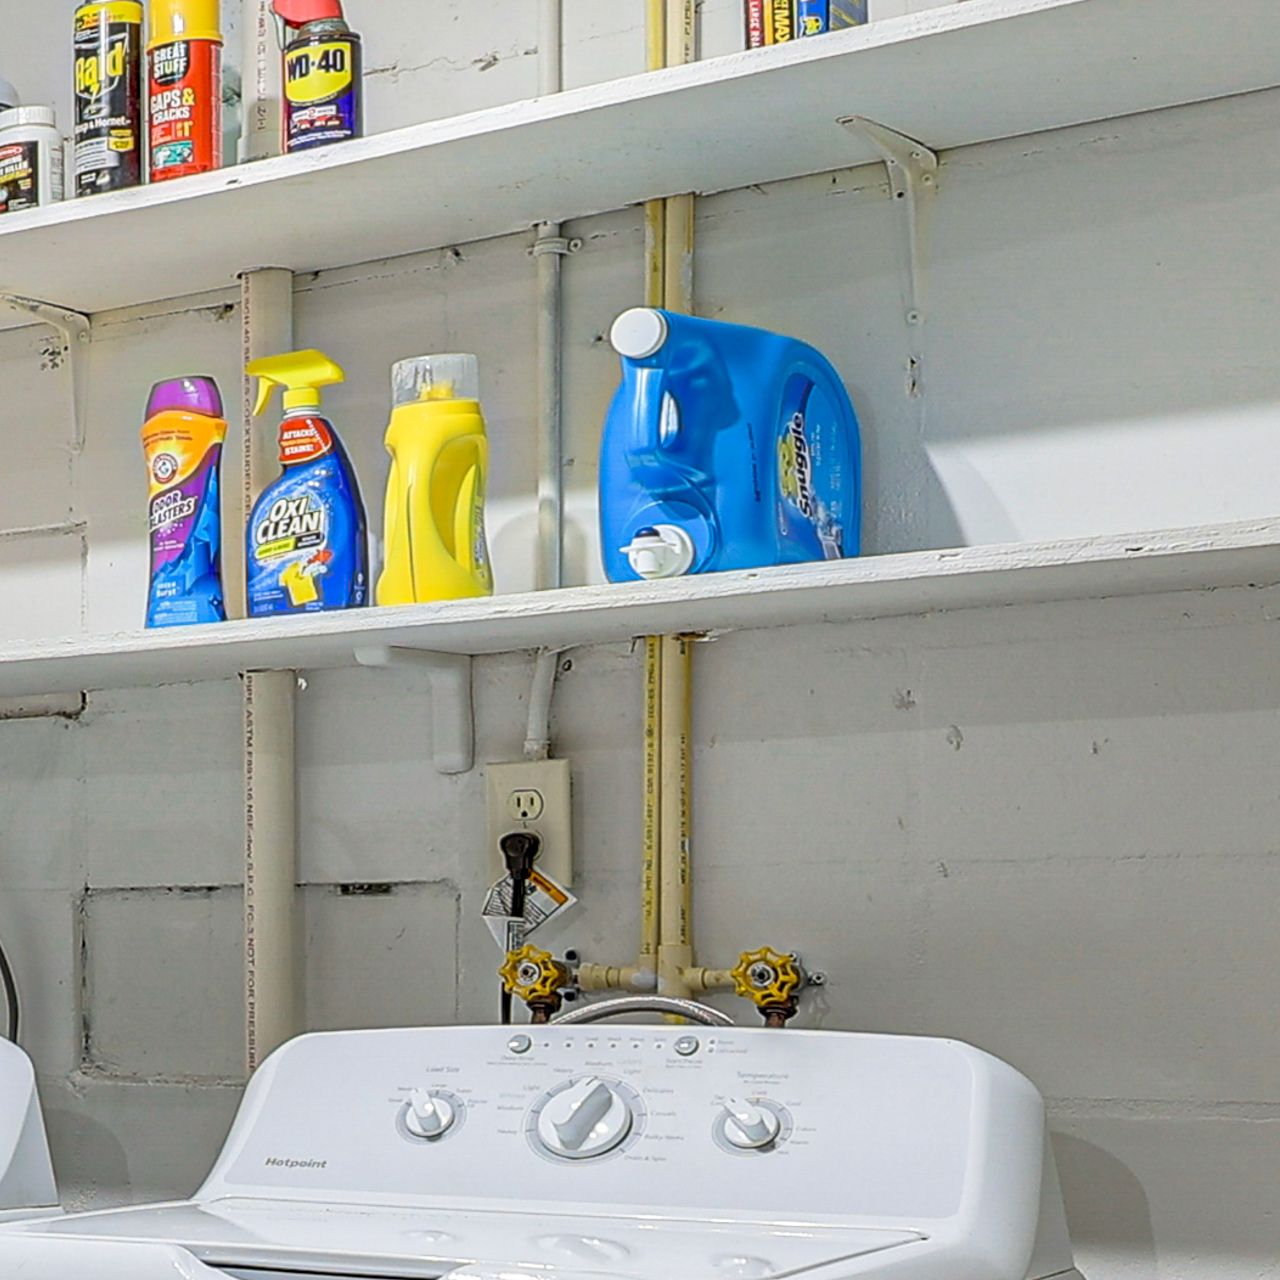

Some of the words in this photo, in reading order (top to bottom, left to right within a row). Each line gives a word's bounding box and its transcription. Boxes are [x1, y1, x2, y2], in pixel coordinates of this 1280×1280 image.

[153, 42, 187, 63] GREAT
[76, 42, 124, 92] Rad
[153, 58, 187, 79] STUFF
[287, 49, 346, 85] WD-40
[151, 89, 180, 114] GAPS
[182, 87, 195, 106] &
[152, 106, 190, 126] CRACKS
[791, 412, 815, 521] Snuggle
[153, 491, 181, 513] ODOR
[270, 497, 309, 523] OXI
[256, 511, 321, 545] CLEAN
[247, 937, 255, 966] NOT
[265, 1157, 328, 1169] Hotpoint
